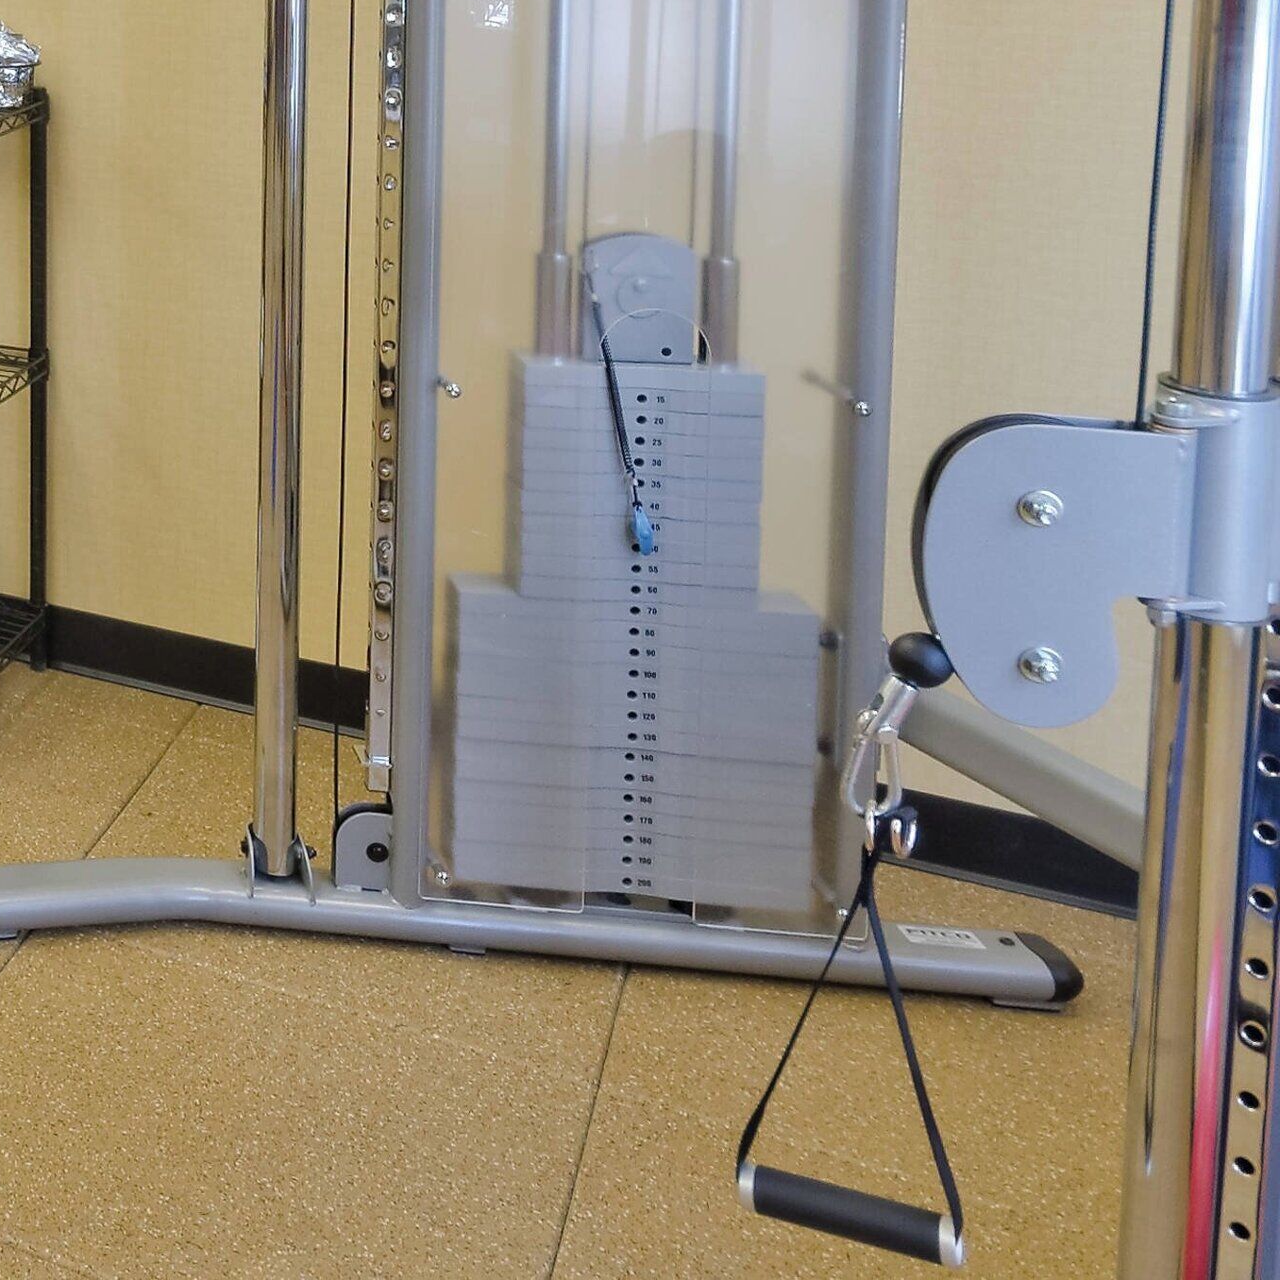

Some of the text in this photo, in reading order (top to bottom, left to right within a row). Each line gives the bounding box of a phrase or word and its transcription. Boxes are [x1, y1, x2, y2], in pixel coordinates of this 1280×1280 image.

[653, 417, 664, 425] 20
[652, 438, 662, 446] 25
[651, 480, 661, 488] 35
[647, 607, 657, 615] 70
[643, 671, 657, 679] 100
[642, 692, 656, 700] 110
